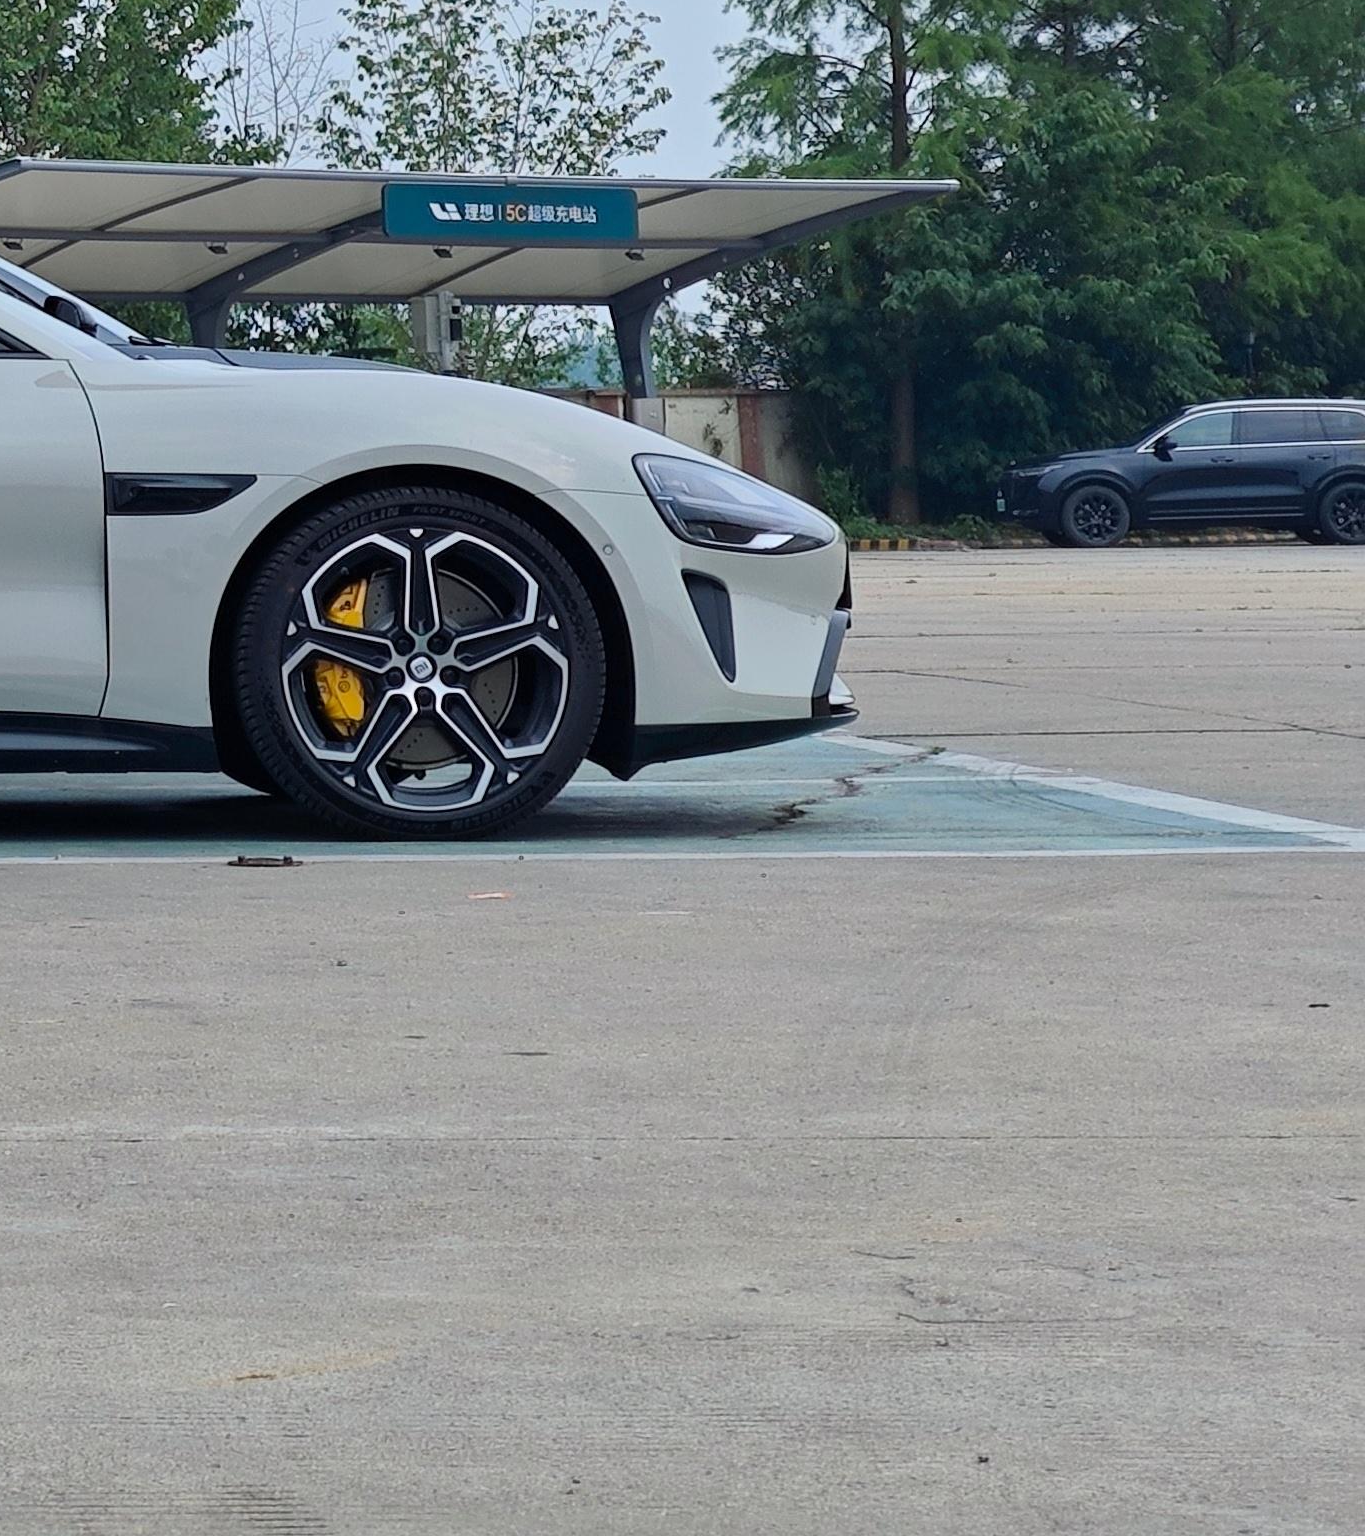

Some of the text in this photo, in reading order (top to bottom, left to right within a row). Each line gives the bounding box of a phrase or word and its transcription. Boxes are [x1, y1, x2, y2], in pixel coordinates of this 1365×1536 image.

[464, 203, 597, 224] 理想 5C超级充电站
[317, 506, 400, 550] MICHELIN
